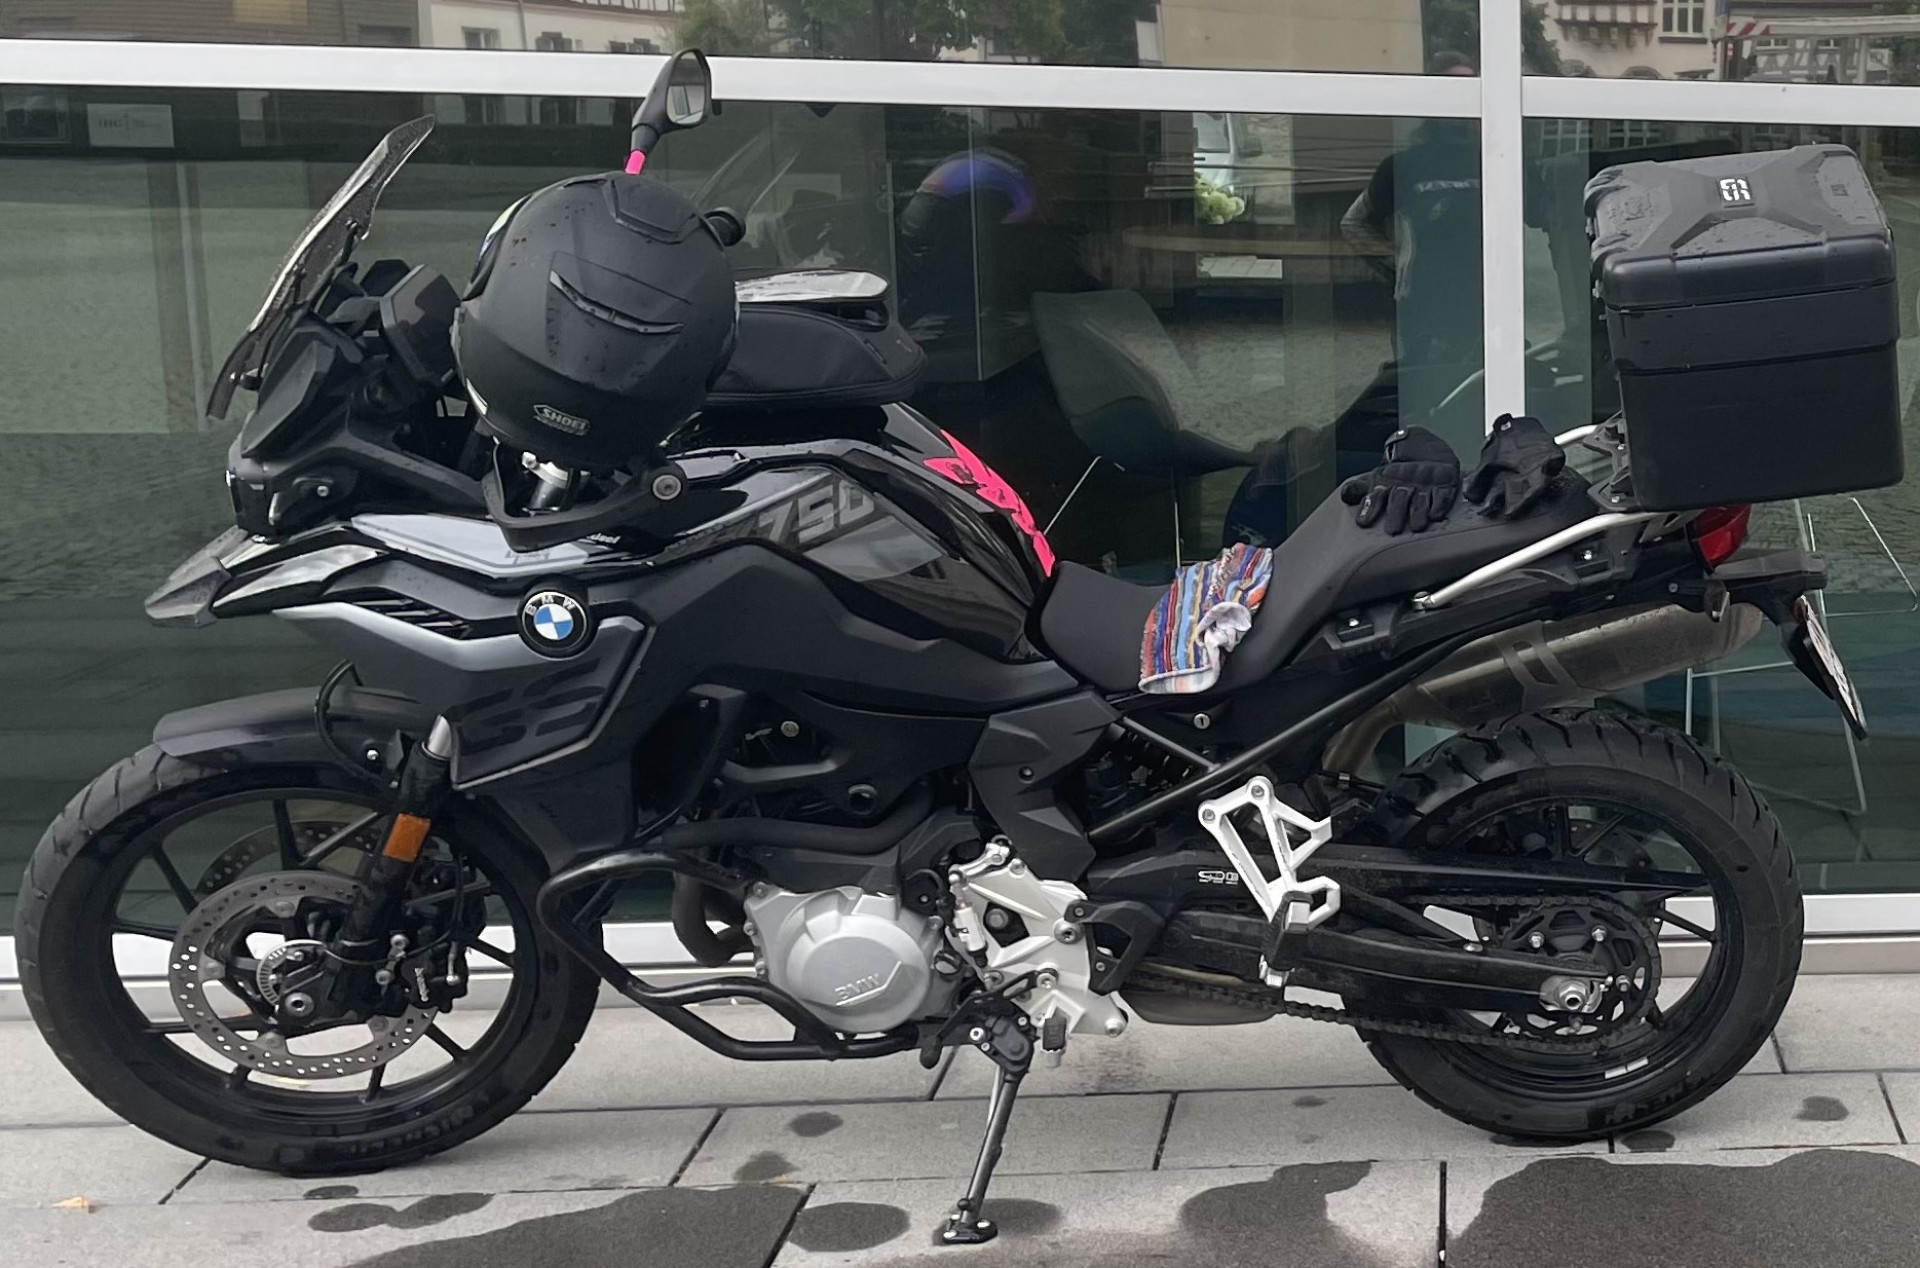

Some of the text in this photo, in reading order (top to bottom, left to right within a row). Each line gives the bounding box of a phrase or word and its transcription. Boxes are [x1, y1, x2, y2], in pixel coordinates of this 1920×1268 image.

[541, 407, 587, 430] SHOEI
[525, 594, 577, 617] BMW
[835, 973, 880, 1000] BMW
